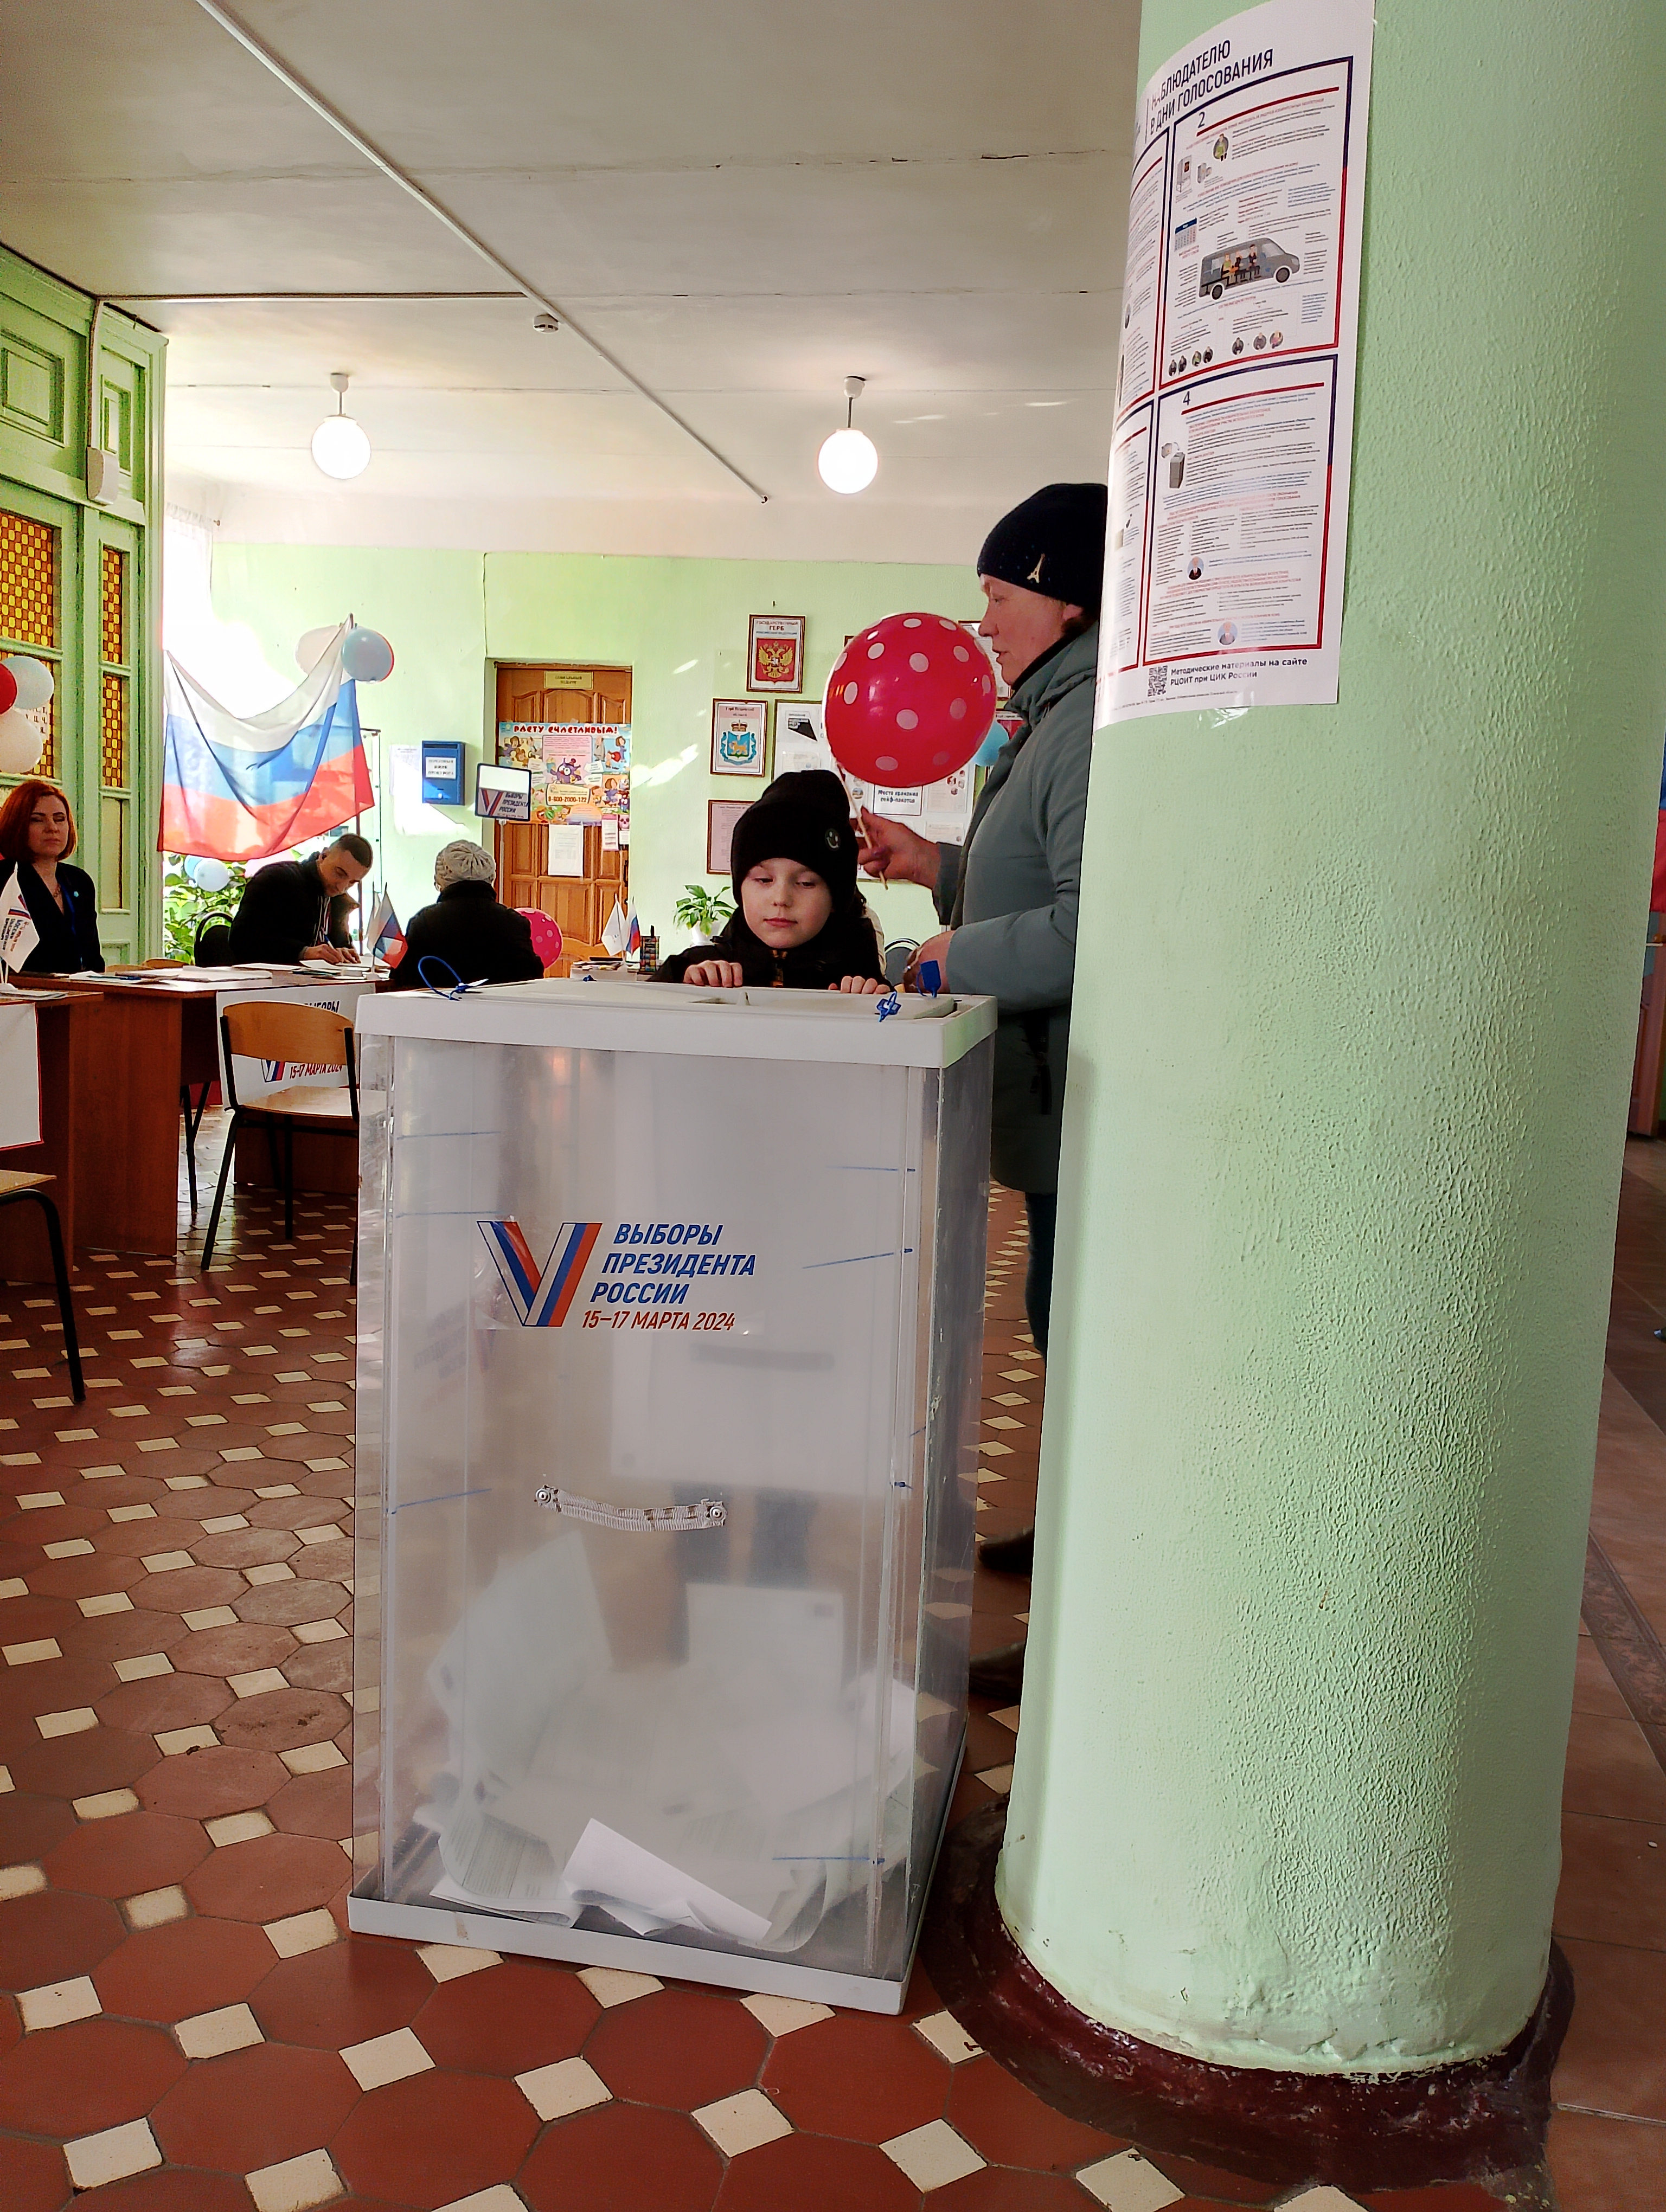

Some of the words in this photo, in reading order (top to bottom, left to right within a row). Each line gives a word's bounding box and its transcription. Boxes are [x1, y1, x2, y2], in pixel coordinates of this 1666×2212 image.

[1156, 98, 1175, 132] ДНИ
[1177, 48, 1273, 112] ГОЛОСОВАНИЯ
[1197, 111, 1206, 128] 2
[1182, 391, 1191, 406] 4
[1171, 664, 1220, 676] Методические
[1221, 659, 1266, 670] материалы
[1282, 657, 1308, 666] сайте
[1170, 676, 1193, 686] РЦОИТ
[1210, 672, 1226, 681] ЦИК
[548, 725, 618, 734] СЧАСТЛИВЫМ!
[613, 1223, 724, 1246] ВЫБОРЫ
[601, 1253, 757, 1278] ПРЕЗИДЕНТА
[589, 1282, 690, 1304] РОССИИ
[631, 1311, 689, 1330] МАРТА
[691, 1312, 736, 1332] 2024
